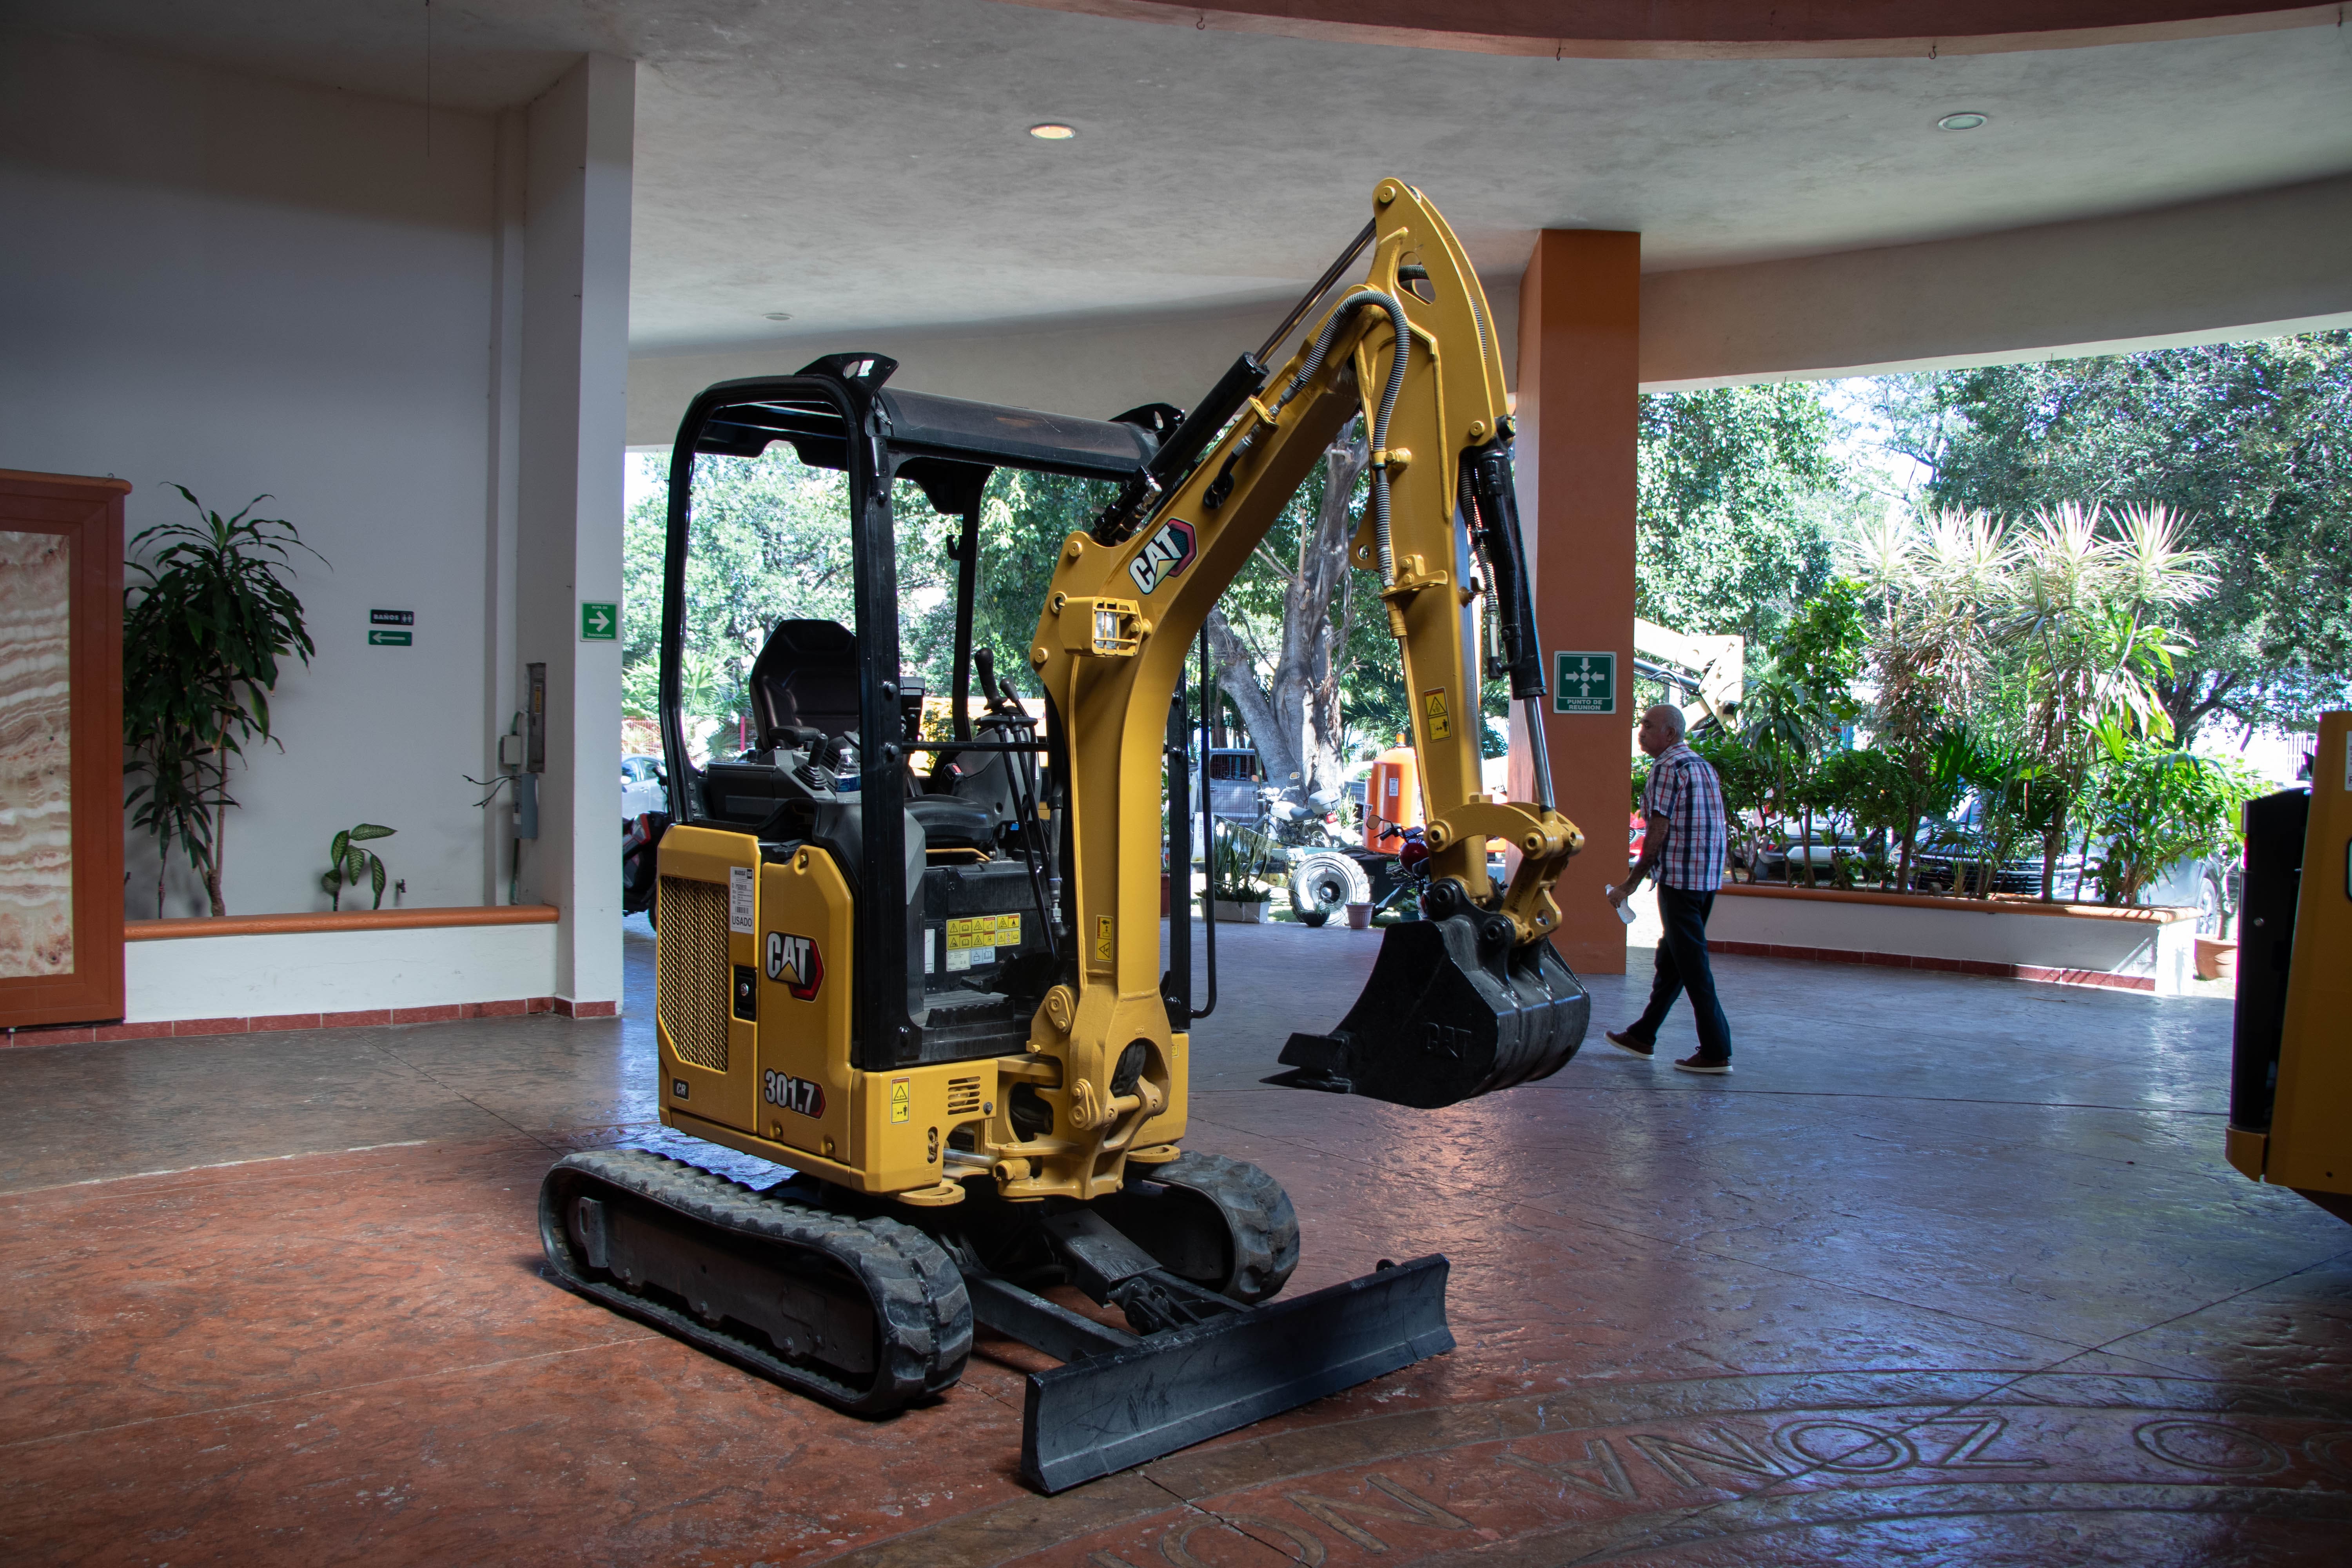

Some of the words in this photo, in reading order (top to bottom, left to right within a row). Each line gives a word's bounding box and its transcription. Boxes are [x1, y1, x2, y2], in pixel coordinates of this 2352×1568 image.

[1129, 525, 1182, 594] CAT
[732, 916, 752, 927] USADO
[767, 933, 810, 984] CAT
[1422, 1022, 1472, 1059] CAT
[676, 1082, 686, 1095] CR
[765, 1070, 815, 1114] 301.7
